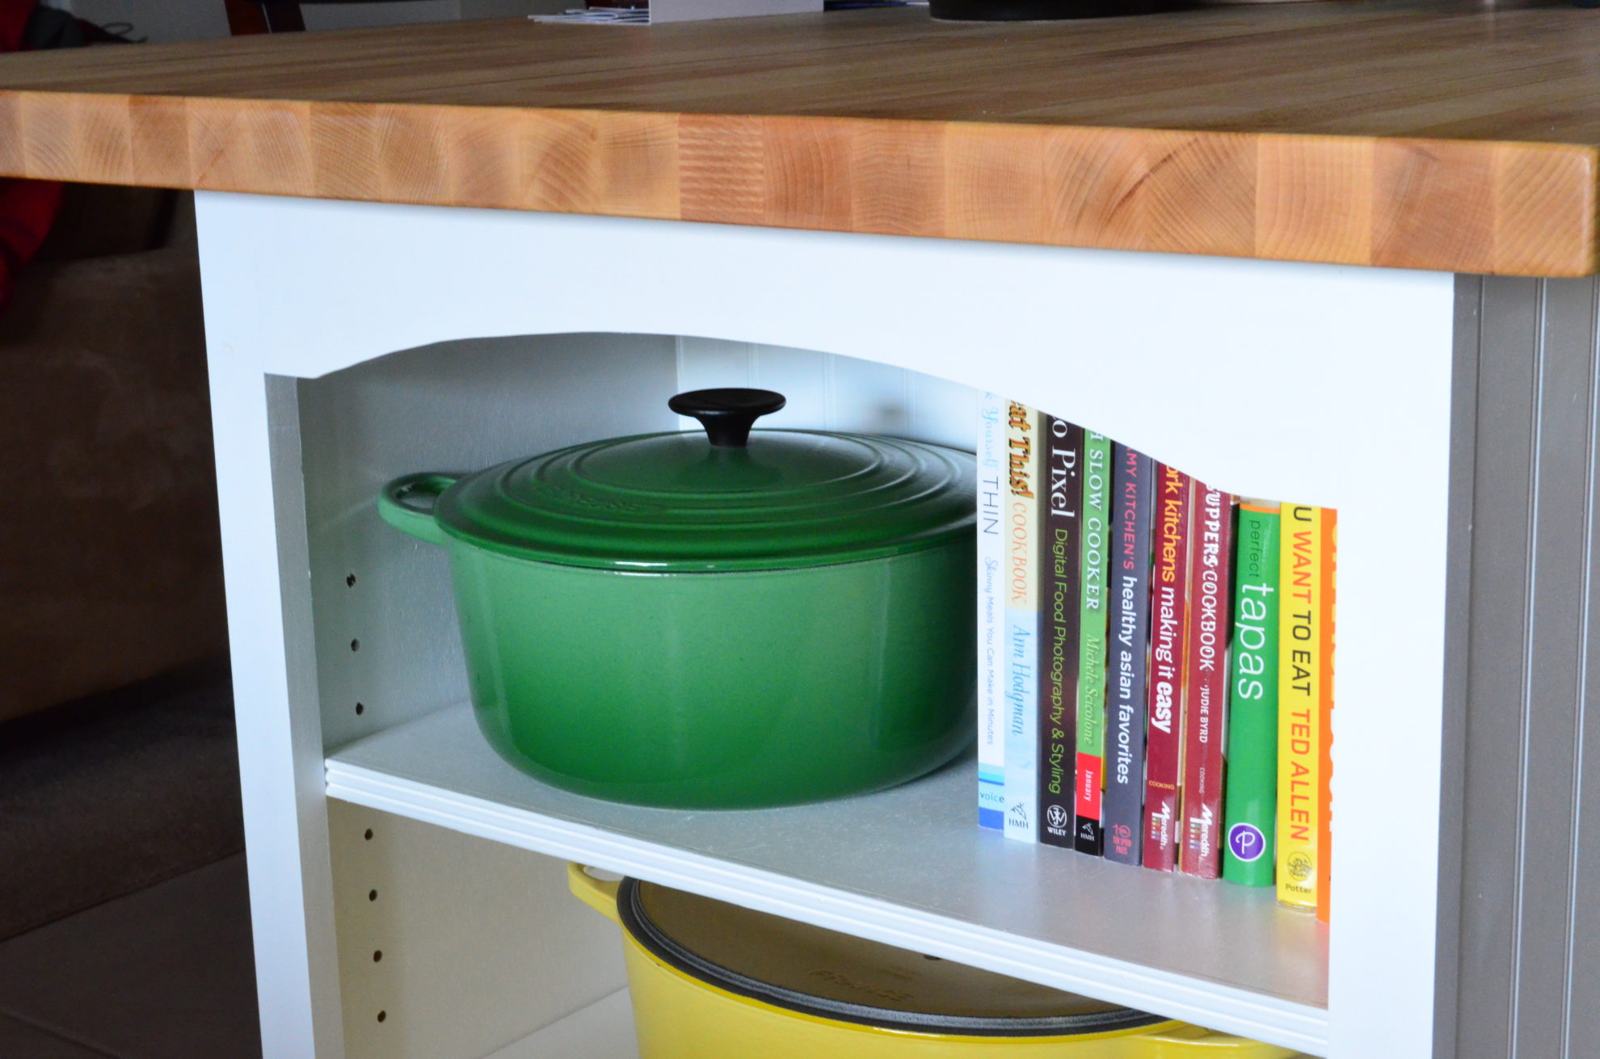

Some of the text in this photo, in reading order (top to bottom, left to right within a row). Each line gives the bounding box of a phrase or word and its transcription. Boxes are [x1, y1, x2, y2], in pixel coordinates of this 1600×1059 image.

[1008, 400, 1031, 432] at
[1008, 436, 1034, 499] This!
[1051, 416, 1076, 518] o Pixel
[1088, 449, 1104, 511] SLOW
[983, 476, 999, 535] THIN
[1086, 517, 1102, 610] COOKER
[1162, 499, 1182, 582] kitchens
[1249, 519, 1262, 577] perfect
[1292, 530, 1312, 605] WANT
[1012, 625, 1031, 659] Ann
[1117, 448, 1138, 784] MY KITCHEN'S healthy asian favorites
[1155, 586, 1178, 663] making
[1199, 569, 1218, 671] COOKBOOK
[1235, 583, 1274, 700] tapas
[1292, 610, 1312, 642] TO
[1048, 528, 1068, 794] Digital Food Photography & Styling
[1158, 666, 1175, 680] it
[1291, 649, 1311, 696] EAT
[1151, 681, 1173, 734] easy
[1199, 717, 1209, 744] BYRD
[980, 791, 1005, 803] voice
[1290, 709, 1310, 841] TED ALLEN
[1047, 826, 1067, 837] WILEY
[1285, 883, 1312, 895] Potter
